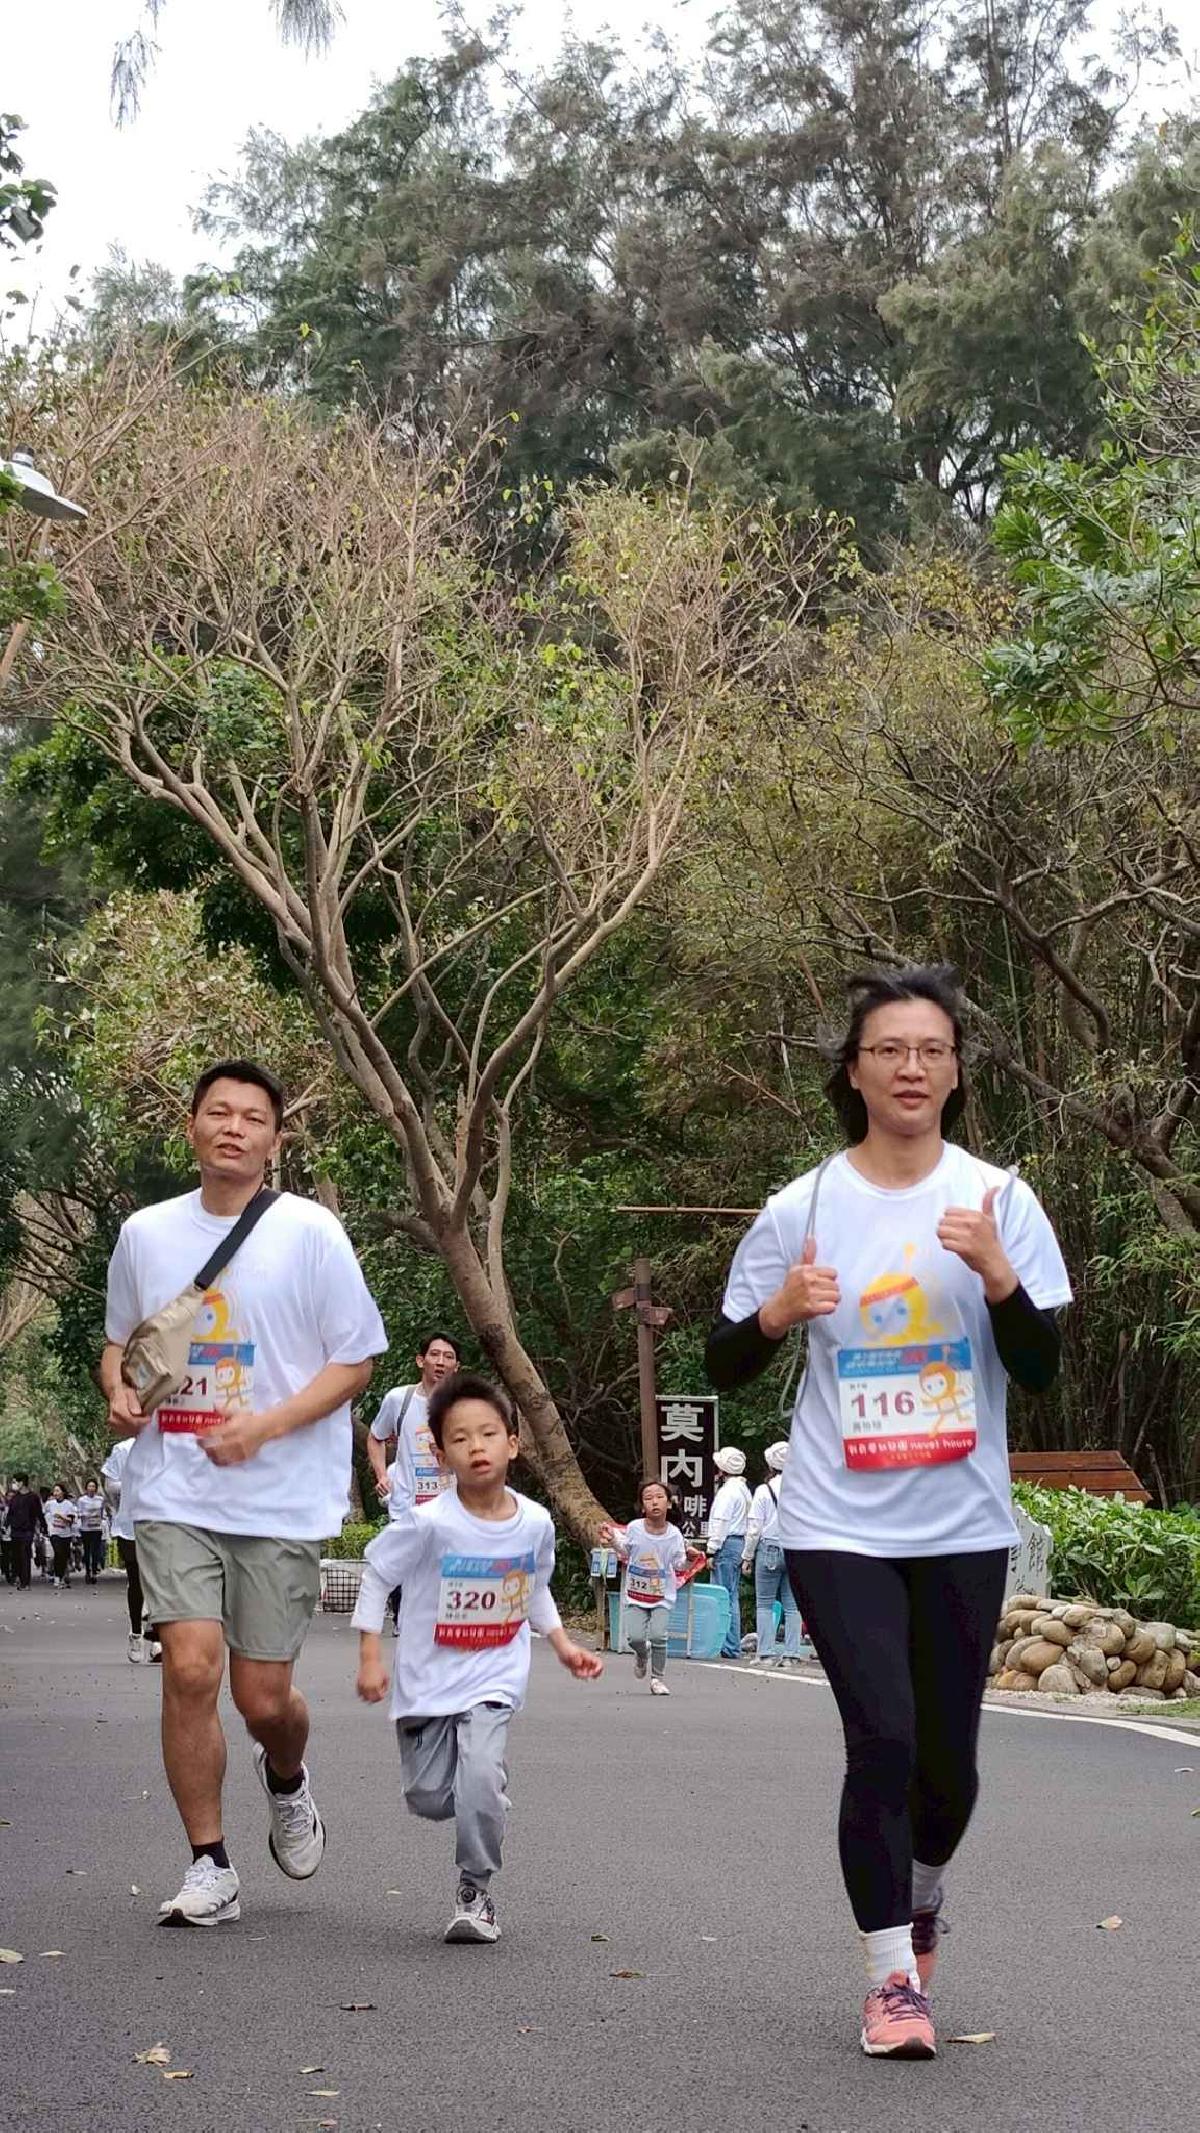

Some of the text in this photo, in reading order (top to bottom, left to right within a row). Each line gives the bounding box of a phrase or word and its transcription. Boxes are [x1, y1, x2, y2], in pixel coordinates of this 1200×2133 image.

[850, 1390, 915, 1418] 116
[660, 1402, 704, 1488] 莫內
[446, 1590, 496, 1611] 320
